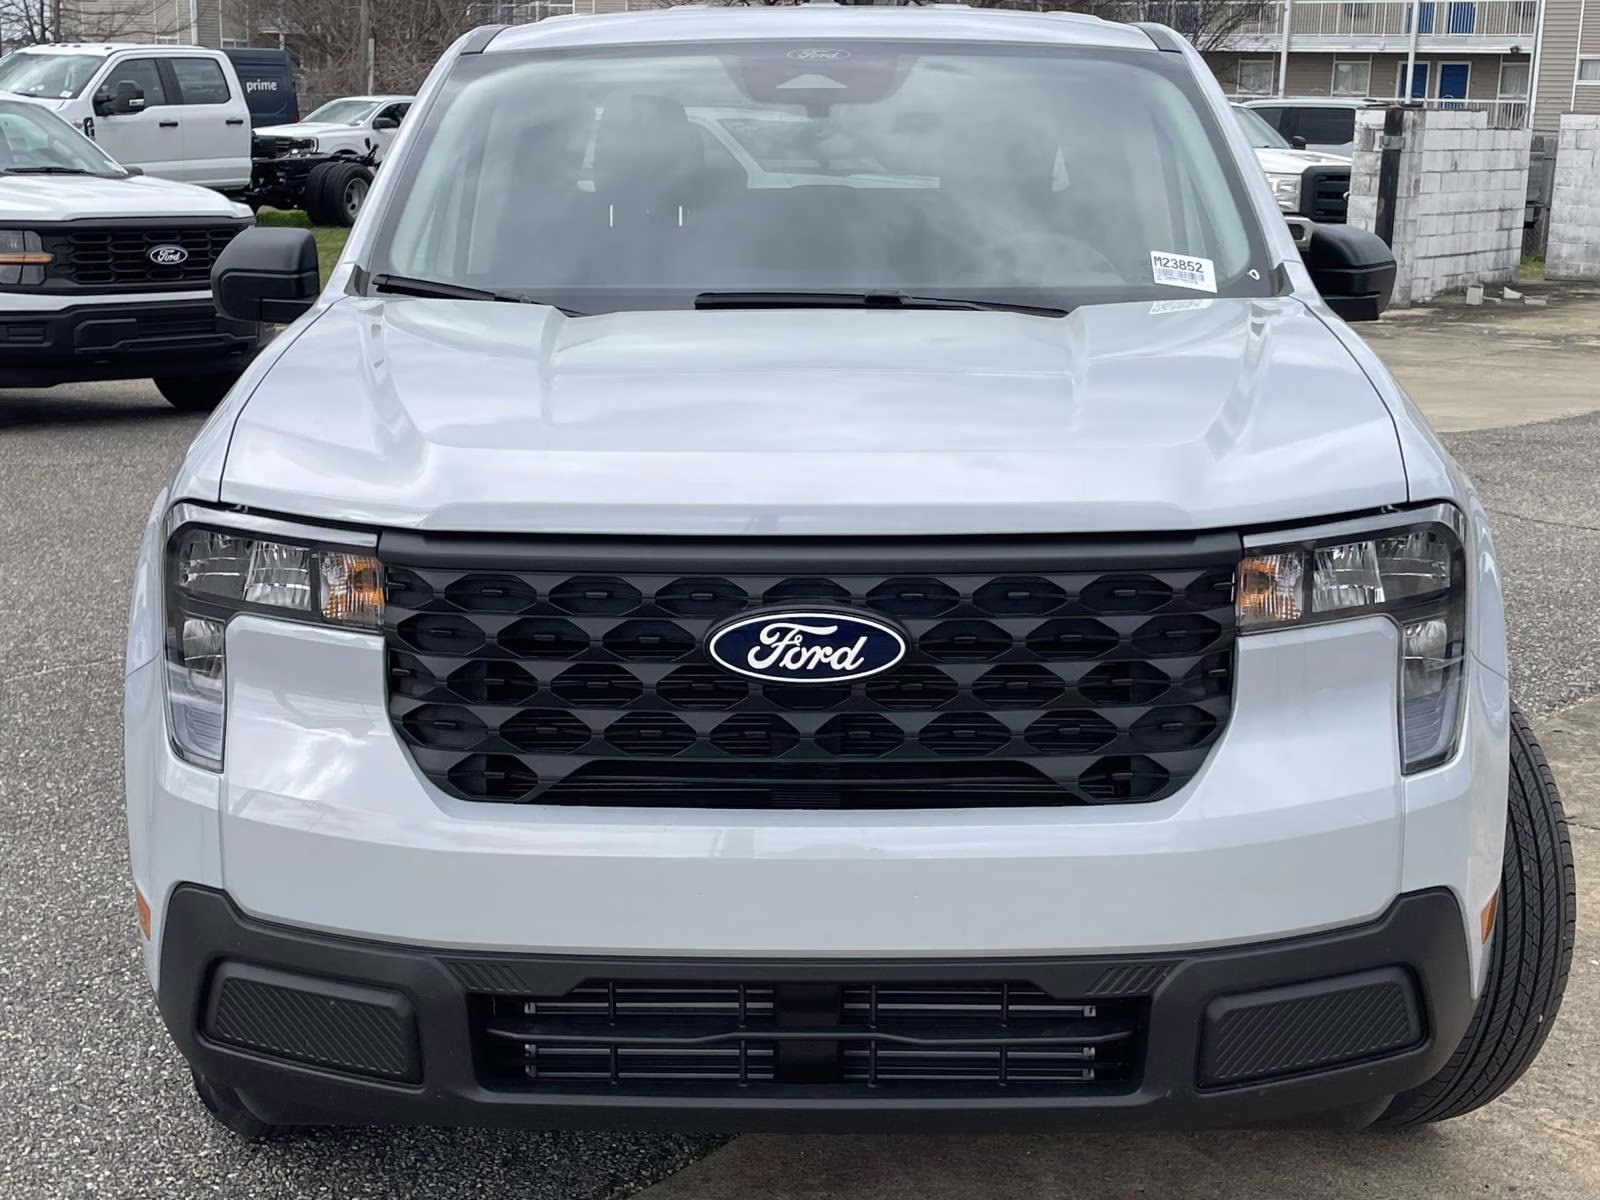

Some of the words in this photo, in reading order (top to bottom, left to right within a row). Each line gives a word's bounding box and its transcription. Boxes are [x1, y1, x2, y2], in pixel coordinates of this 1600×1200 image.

[798, 49, 841, 59] Ford
[246, 78, 278, 94] prime
[157, 249, 181, 262] Ford
[1153, 255, 1204, 273] M23852
[747, 622, 868, 670] Ford
